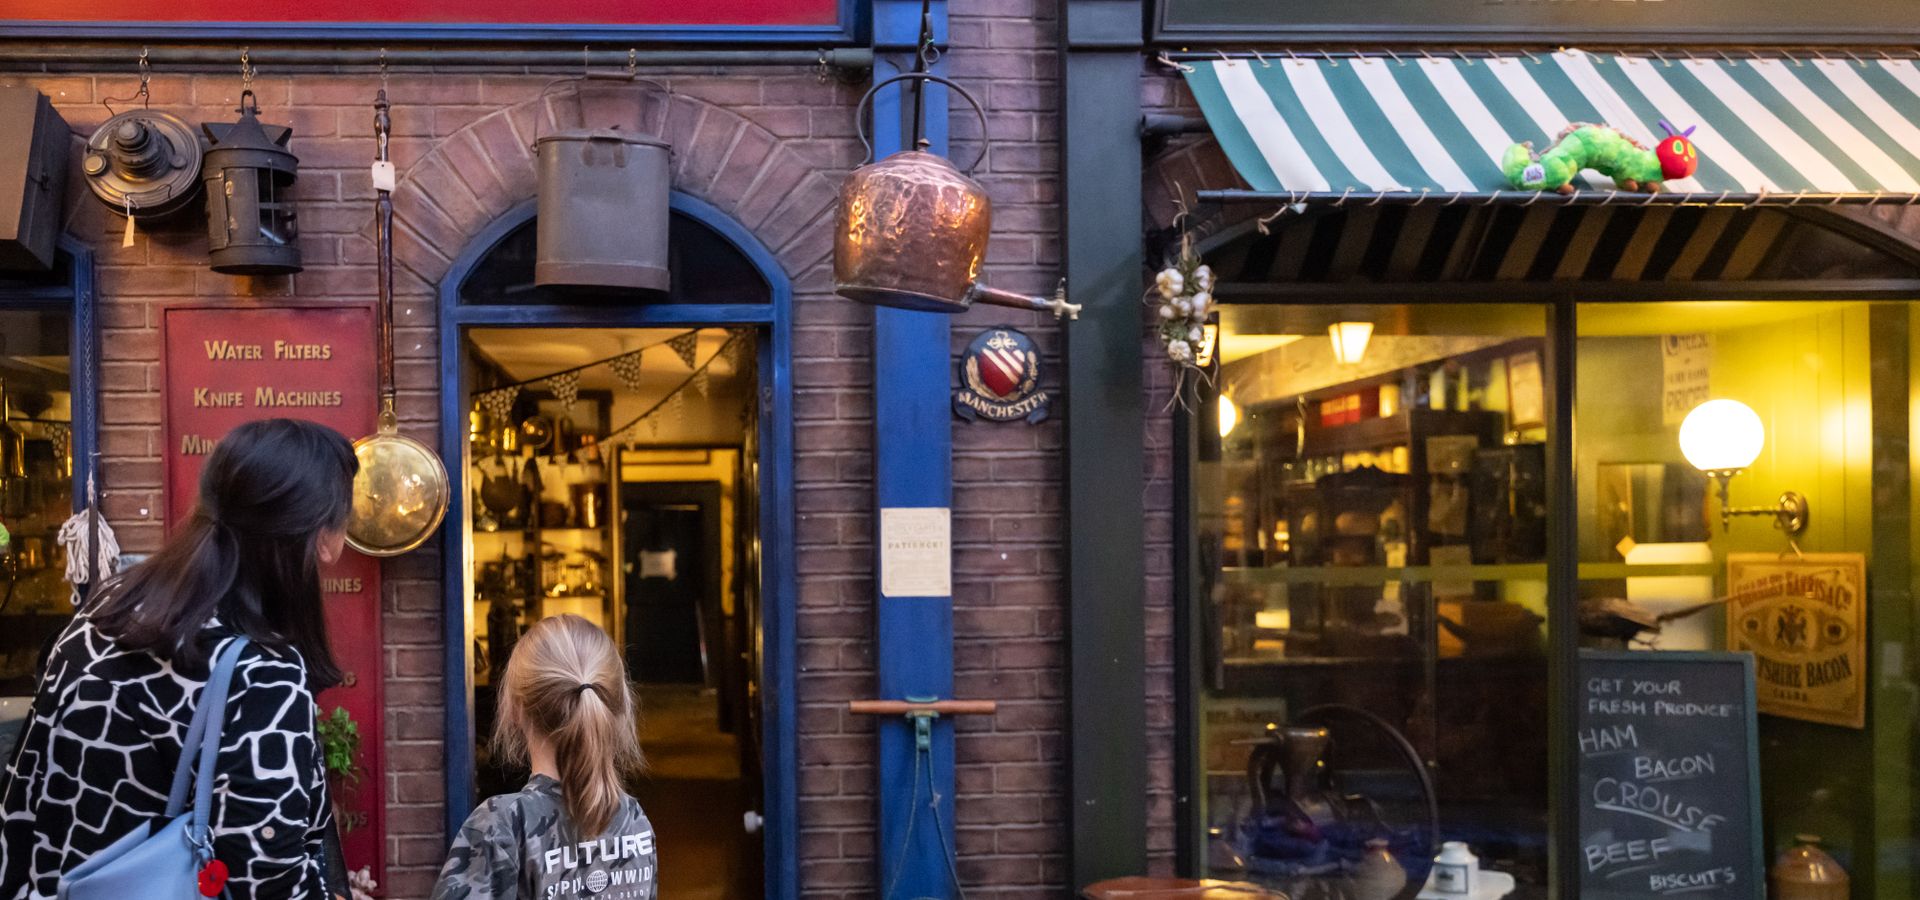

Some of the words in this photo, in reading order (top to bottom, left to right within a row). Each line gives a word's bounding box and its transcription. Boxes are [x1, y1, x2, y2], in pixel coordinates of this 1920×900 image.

[958, 391, 1048, 418] MANCHESTER
[1806, 654, 1852, 688] BACON
[1587, 678, 1624, 694] GET
[1632, 680, 1682, 695] YOUR
[1588, 698, 1646, 716] FRESH
[1654, 700, 1732, 718] PRODUCE
[1577, 724, 1638, 753] HAM
[1635, 752, 1716, 779] BACON
[544, 830, 653, 874] FUTURE
[1585, 838, 1674, 873] BEEF
